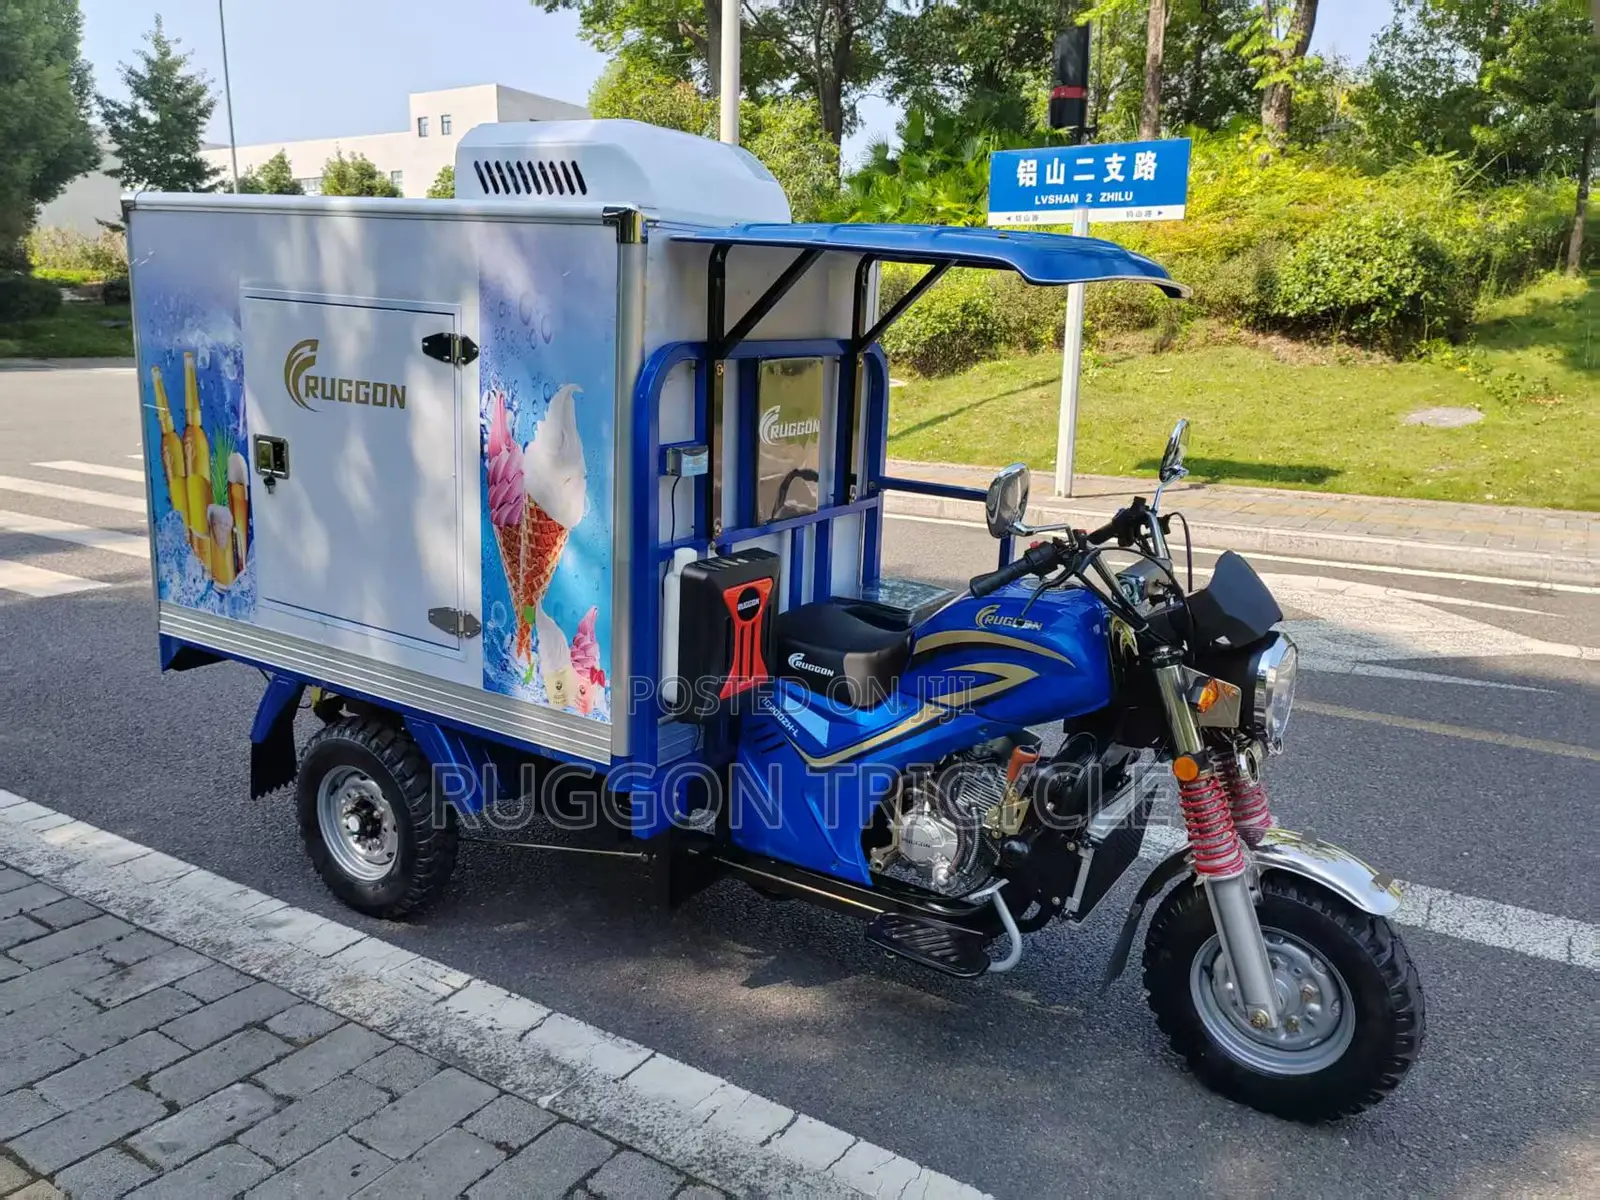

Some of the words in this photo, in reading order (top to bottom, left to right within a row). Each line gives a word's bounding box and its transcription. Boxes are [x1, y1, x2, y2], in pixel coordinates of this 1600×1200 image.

[1016, 150, 1158, 187] 铝山二支路
[1035, 193, 1079, 205] LVSHAN
[1085, 193, 1093, 203] 2
[1100, 191, 1133, 202] ZHILU
[305, 375, 406, 409] RUGGON
[770, 419, 820, 439] RUGGON
[795, 660, 834, 677] RUGGON
